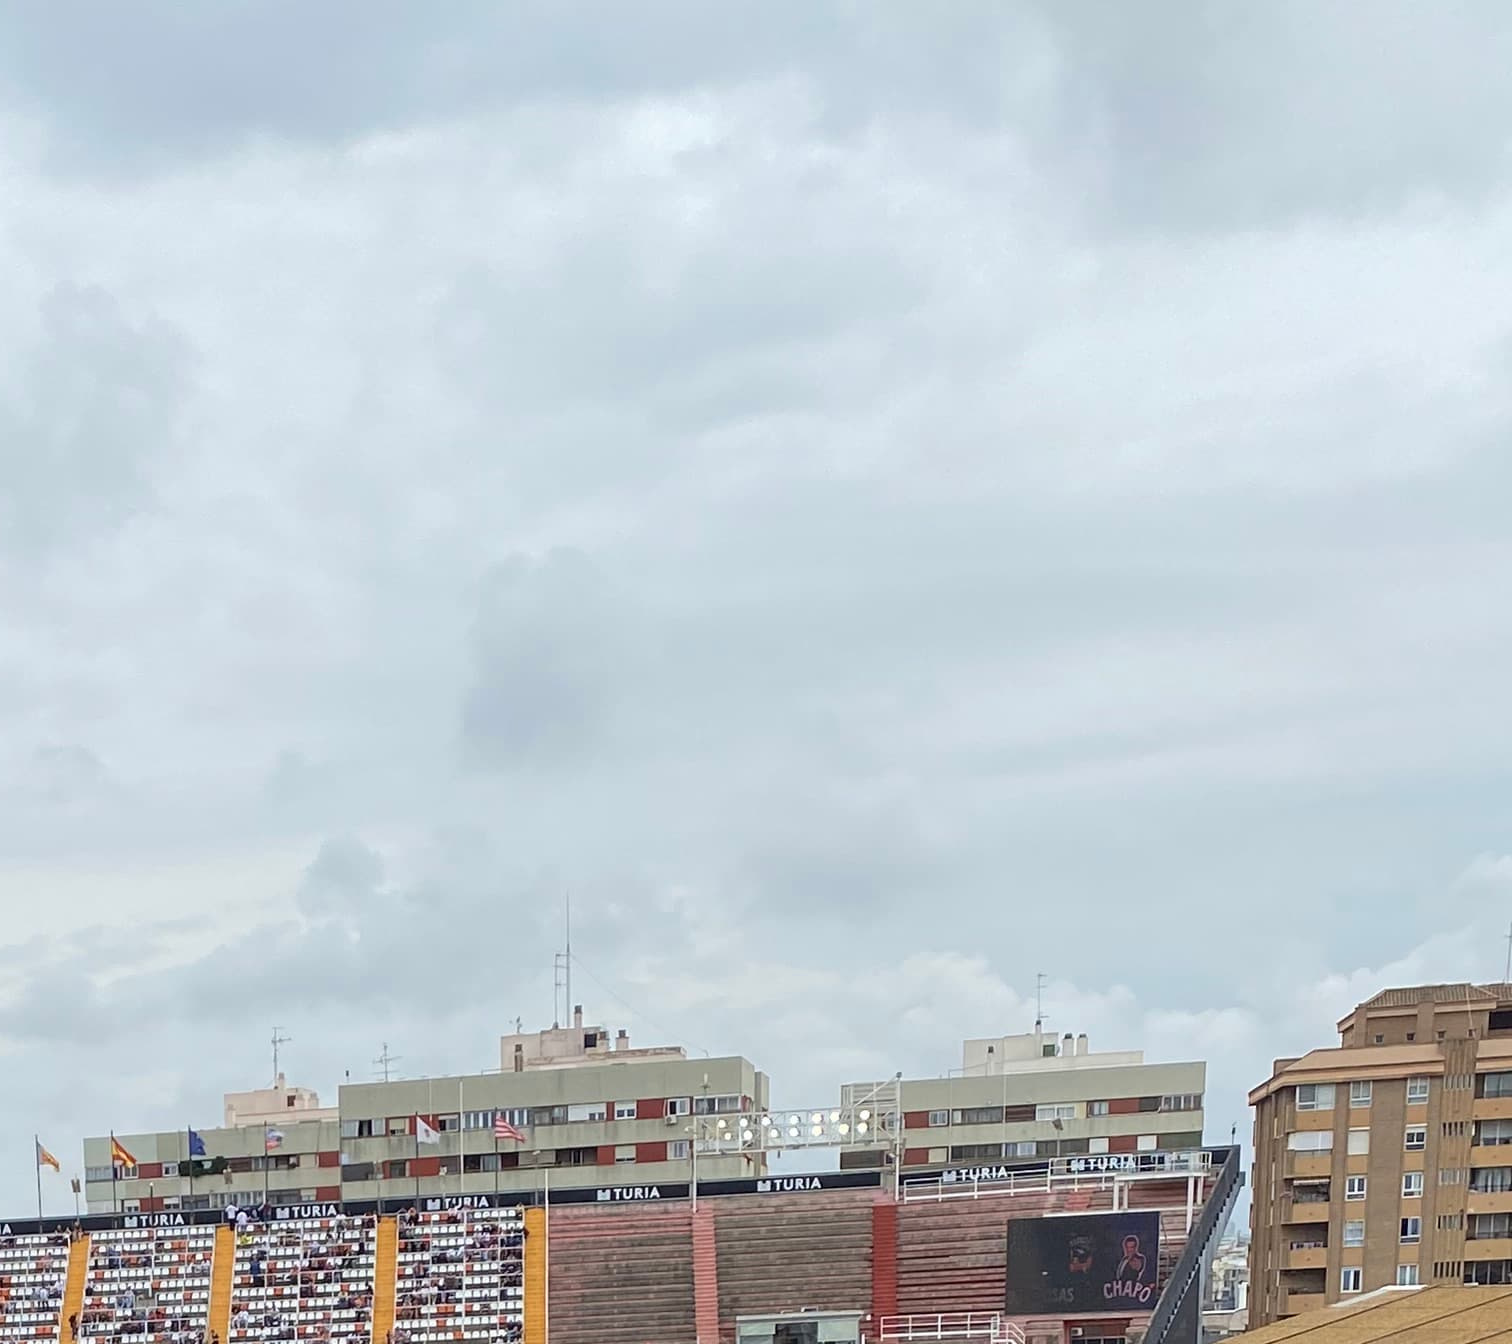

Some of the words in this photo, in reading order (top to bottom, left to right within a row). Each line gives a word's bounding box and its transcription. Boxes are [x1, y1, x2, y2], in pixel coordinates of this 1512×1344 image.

[1088, 1156, 1136, 1170] TURIA
[958, 1166, 1008, 1180] TURIA
[774, 1178, 821, 1191] TURIA
[613, 1186, 660, 1200] TURIA
[291, 1204, 336, 1218] TURIA
[139, 1214, 185, 1227] TURIA
